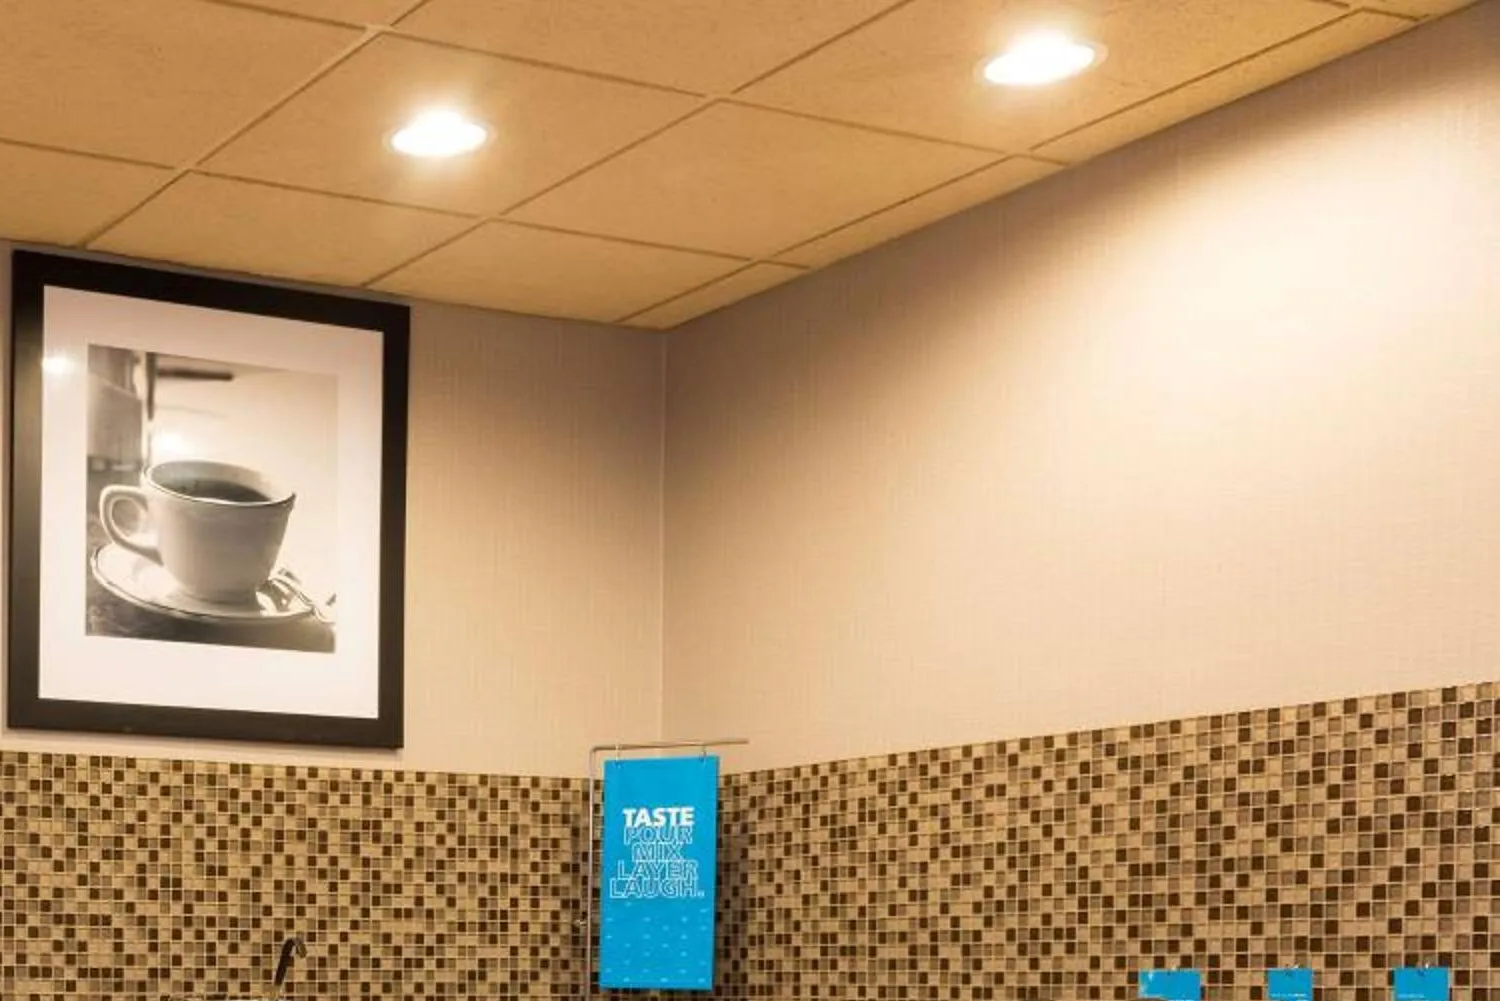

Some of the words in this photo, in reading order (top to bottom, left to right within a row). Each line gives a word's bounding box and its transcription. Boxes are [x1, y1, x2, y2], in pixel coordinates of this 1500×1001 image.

[622, 806, 695, 827] TASTE
[624, 826, 693, 845] POUR
[632, 843, 684, 862] MIX
[617, 860, 698, 881] LAYER
[609, 878, 705, 899] LAUGH.
